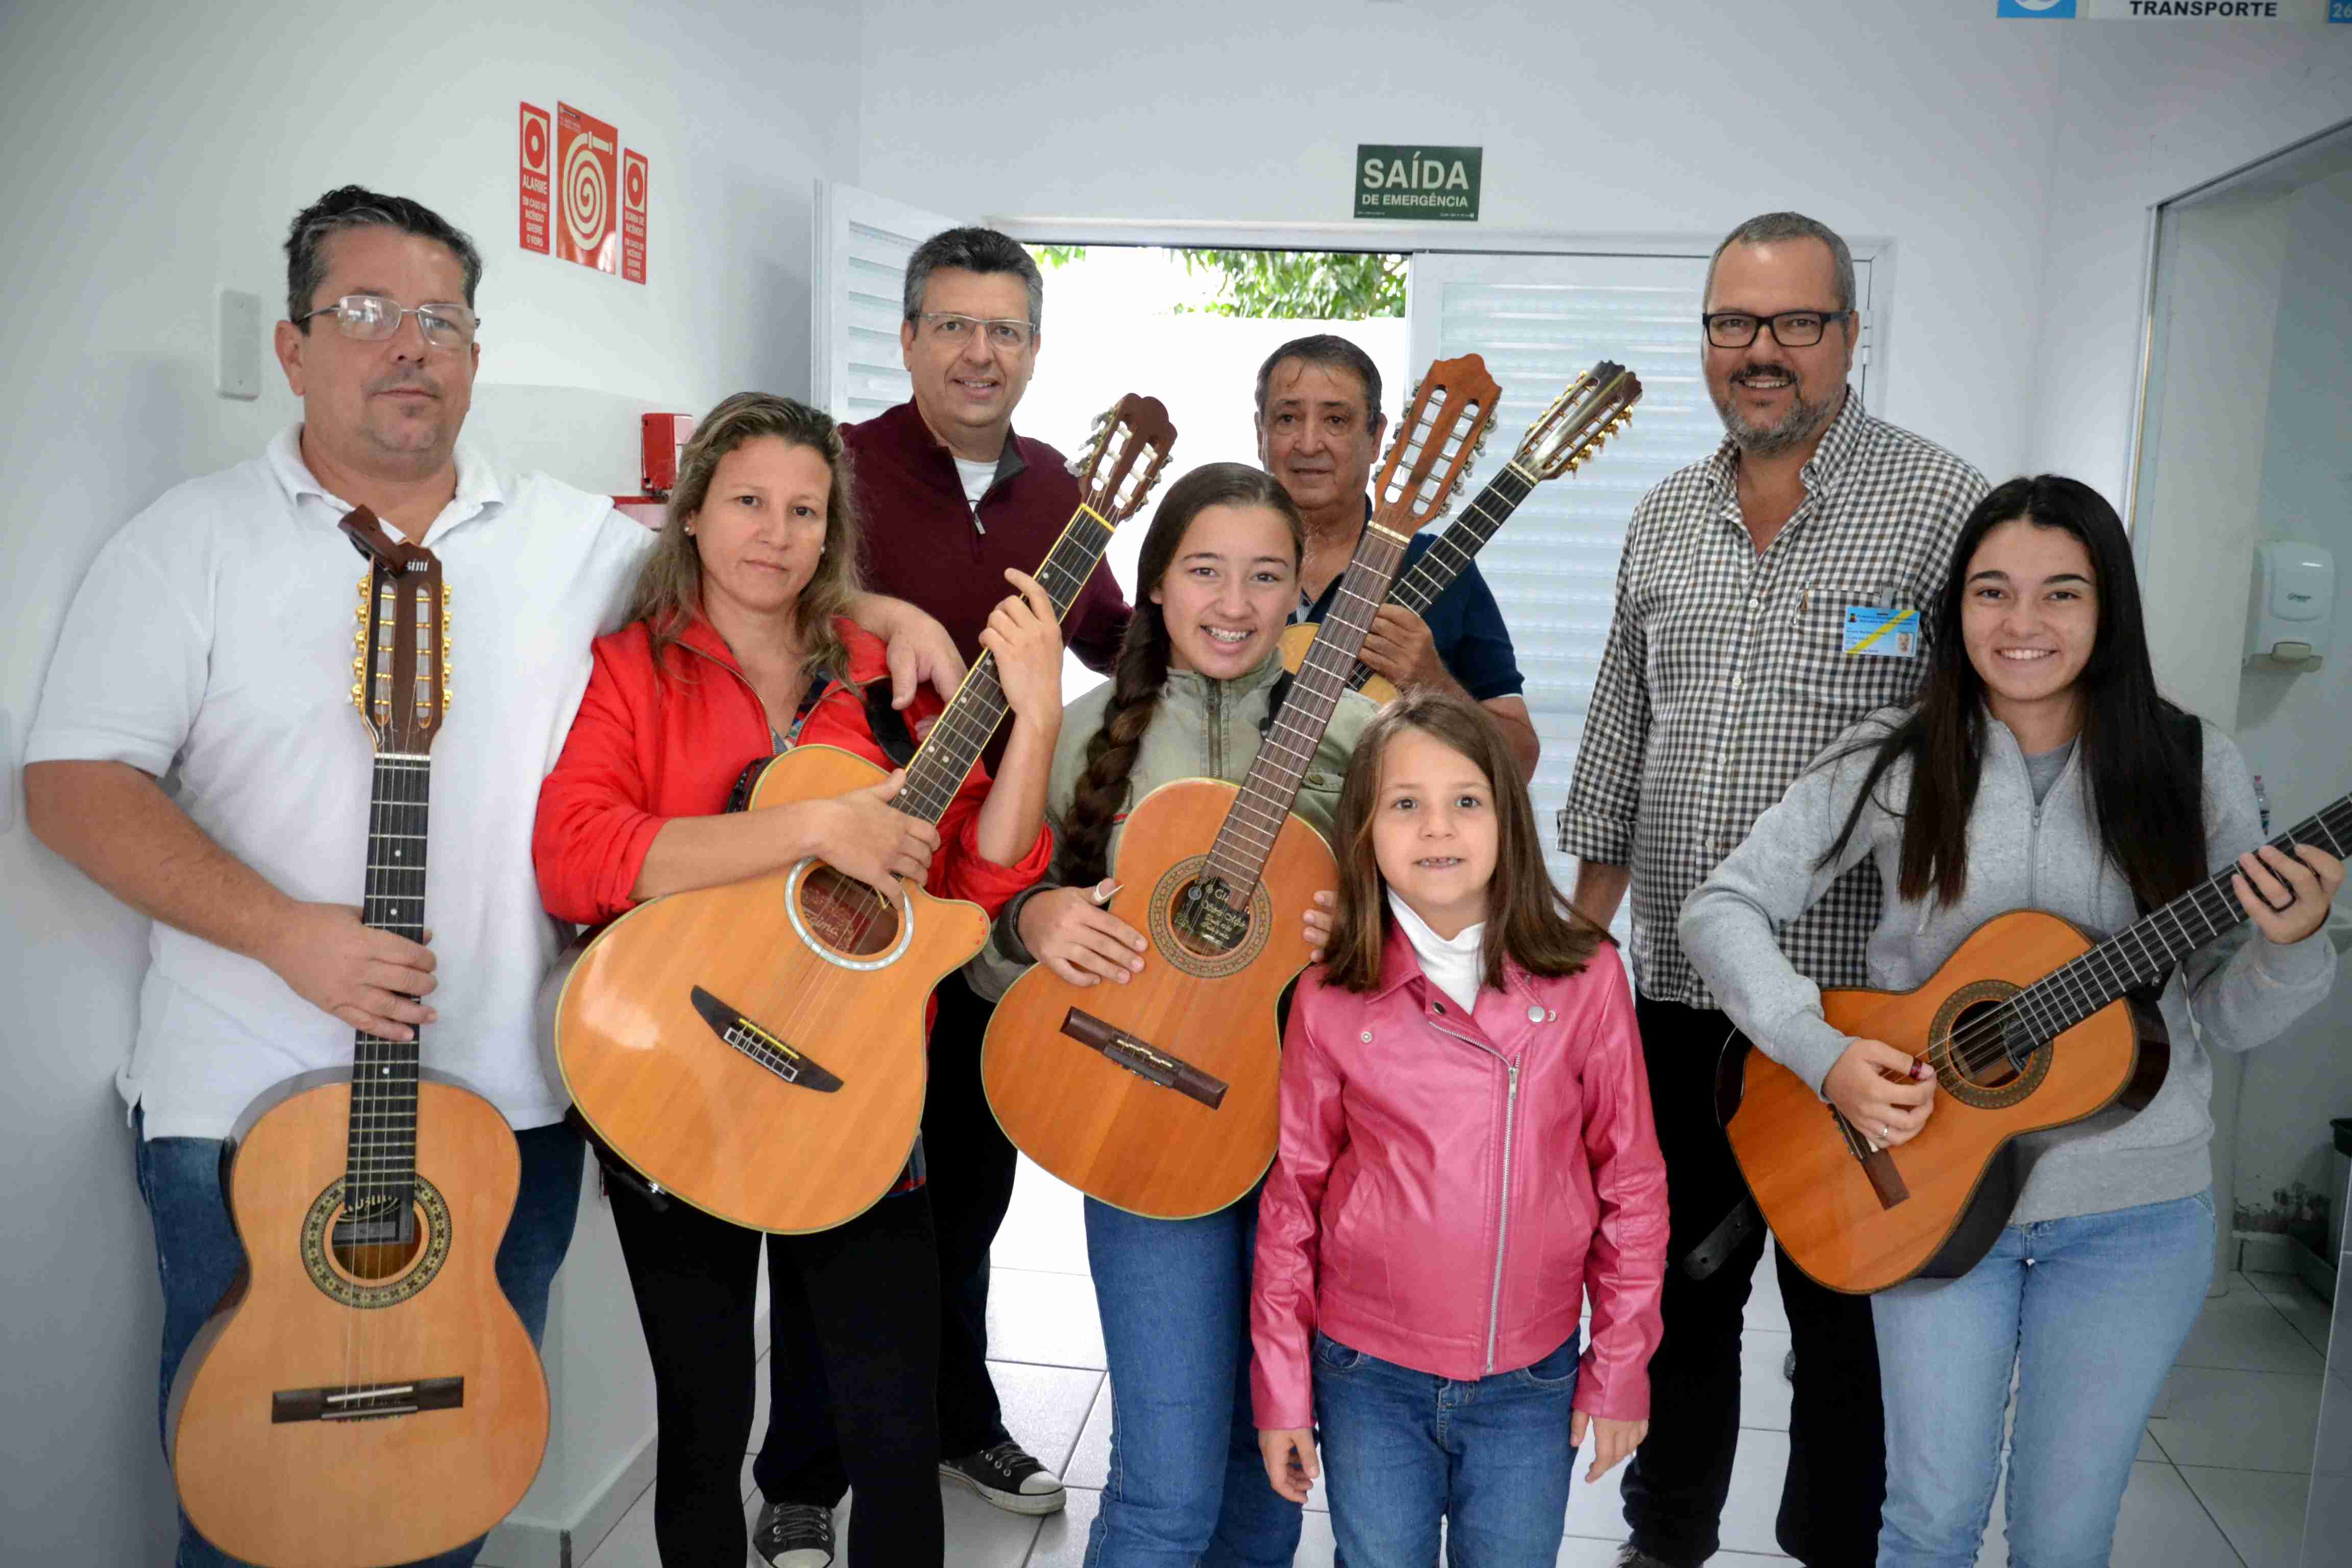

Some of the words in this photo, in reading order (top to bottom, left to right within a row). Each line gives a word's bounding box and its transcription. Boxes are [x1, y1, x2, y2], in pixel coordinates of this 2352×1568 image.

[2129, 1, 2277, 17] TRANSPORTE
[1363, 151, 1469, 190] SAÍDA
[523, 174, 548, 195] ALARME
[1362, 194, 1380, 205] DE
[1383, 192, 1468, 207] EMERGÊNCIA
